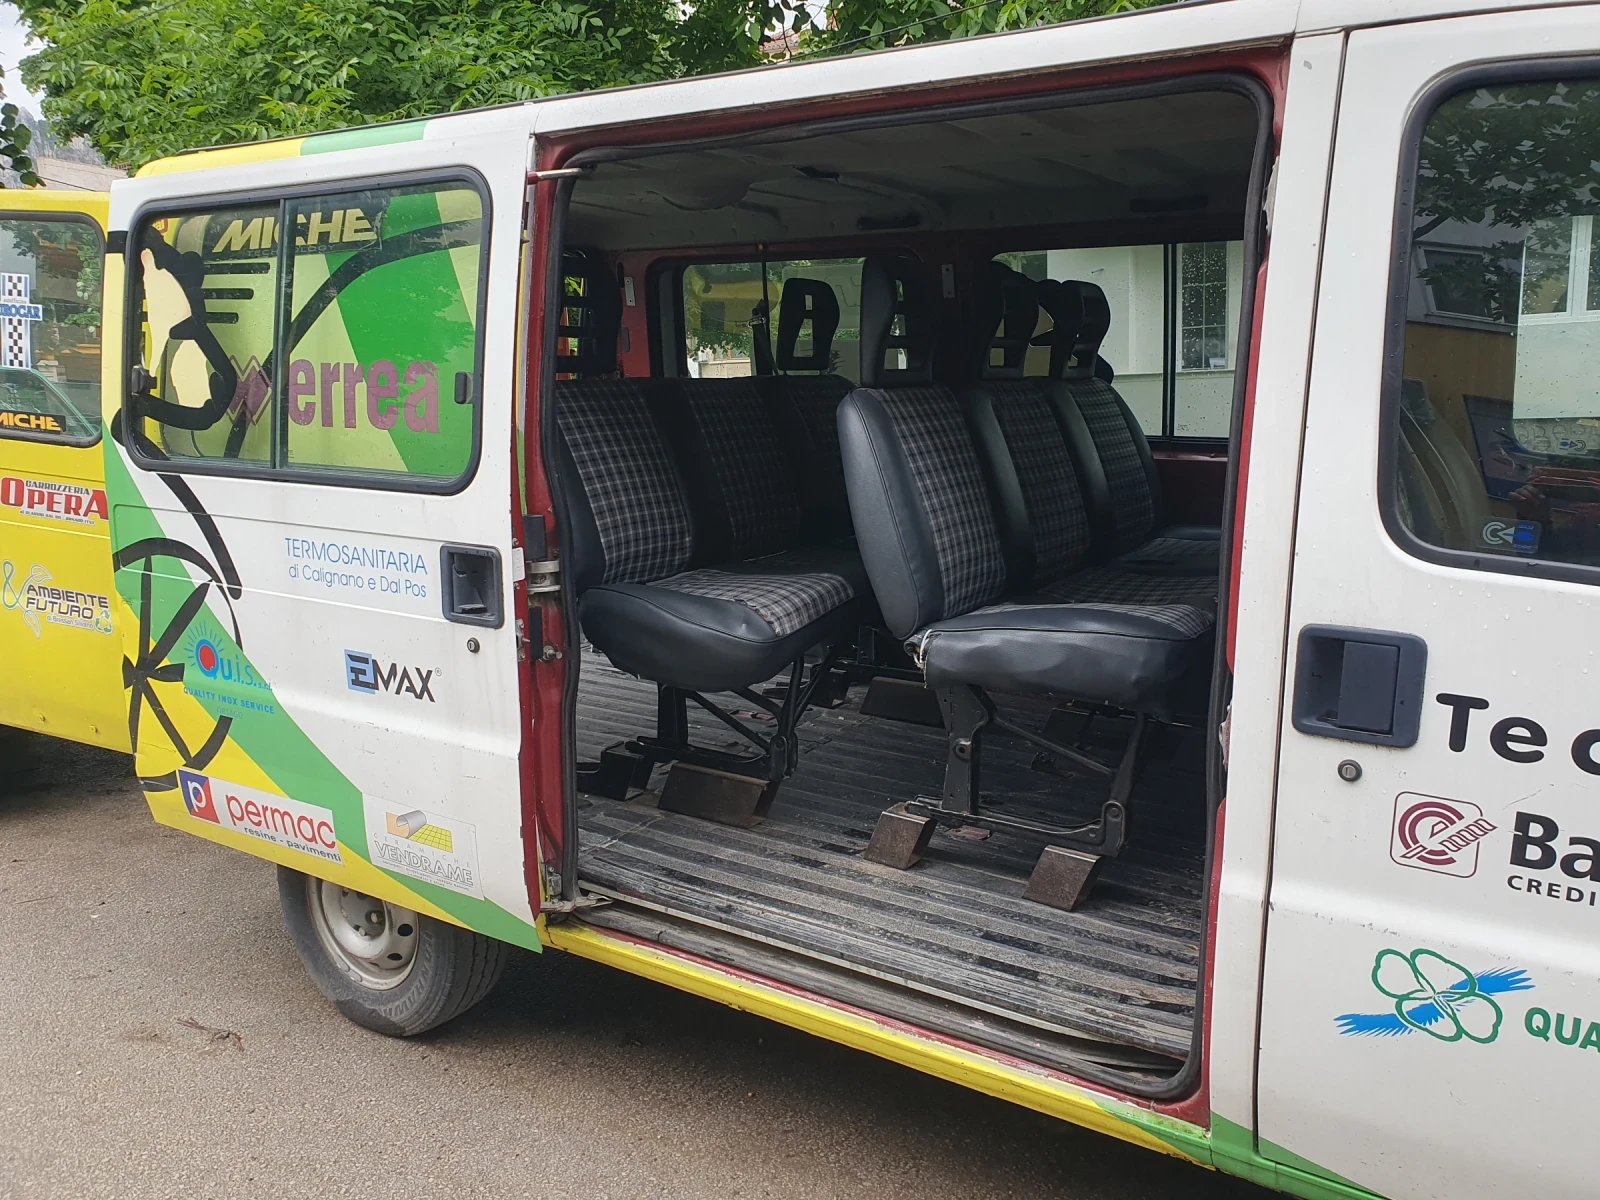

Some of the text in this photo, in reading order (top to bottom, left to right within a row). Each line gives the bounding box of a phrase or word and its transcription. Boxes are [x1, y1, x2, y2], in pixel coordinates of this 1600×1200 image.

[247, 243, 335, 258] TECHLOGY
[1, 477, 109, 520] OPERA
[25, 480, 90, 496] CARROZZERIA
[285, 537, 428, 576] TERMOSANITARIA
[27, 585, 109, 609] AMBIENTE
[288, 564, 427, 598] di Calignano e Dal Pos
[26, 597, 94, 620] FUTURO
[346, 653, 436, 703] EMAX
[183, 686, 275, 715] QUALITY INOX SERVICE
[225, 794, 336, 850] permac
[244, 826, 277, 843] resine
[286, 839, 342, 862] pavimenti
[374, 840, 474, 887] VENDRAME
[1507, 875, 1597, 907] CREDI
[1524, 1007, 1600, 1053] QUA
